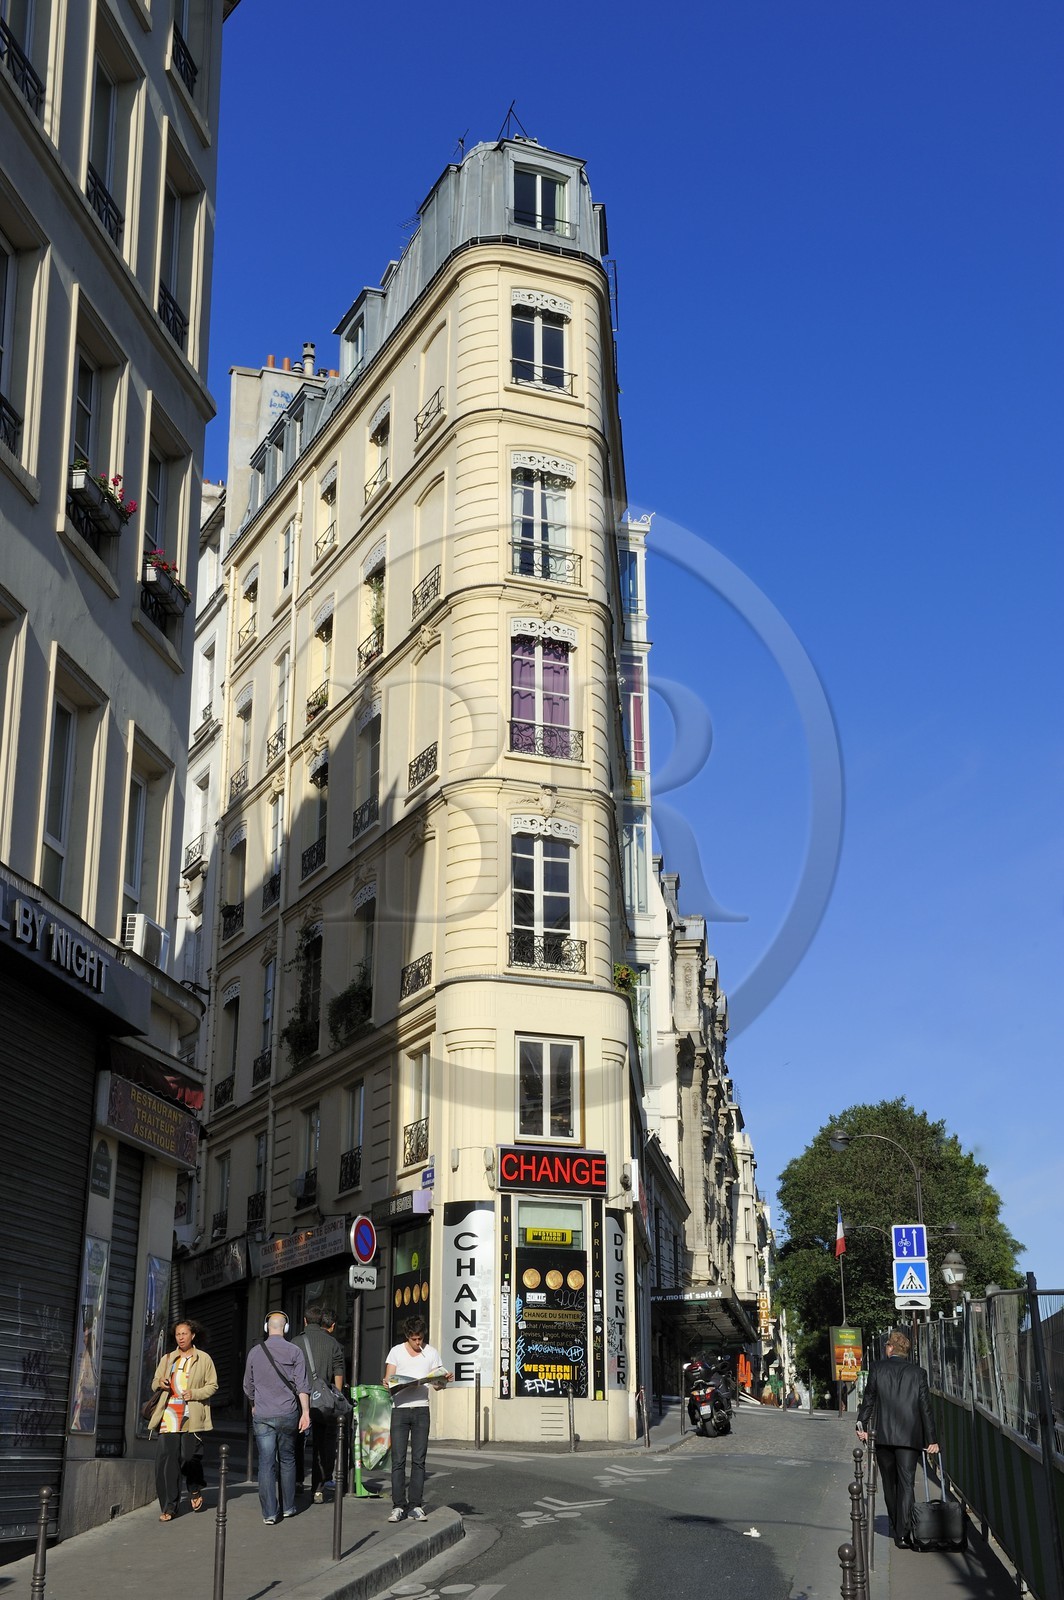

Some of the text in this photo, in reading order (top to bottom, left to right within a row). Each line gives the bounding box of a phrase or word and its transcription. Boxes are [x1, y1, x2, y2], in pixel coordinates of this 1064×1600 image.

[15, 898, 46, 951] BY
[50, 922, 110, 993] NIGHT
[131, 1088, 183, 1125] RESTAURANT
[136, 1107, 175, 1137] TRAITEUR
[133, 1122, 176, 1152] ASIATIQUE
[501, 1153, 606, 1186] CHANGE
[452, 1231, 480, 1382] CHANGE
[524, 1311, 548, 1319] CHANGE
[557, 1312, 580, 1320] SENTIER
[613, 1233, 627, 1386] DU SENTIER
[760, 1291, 770, 1336] HOTEL
[524, 1364, 570, 1373] WESTERN
[538, 1372, 570, 1380] UNION
